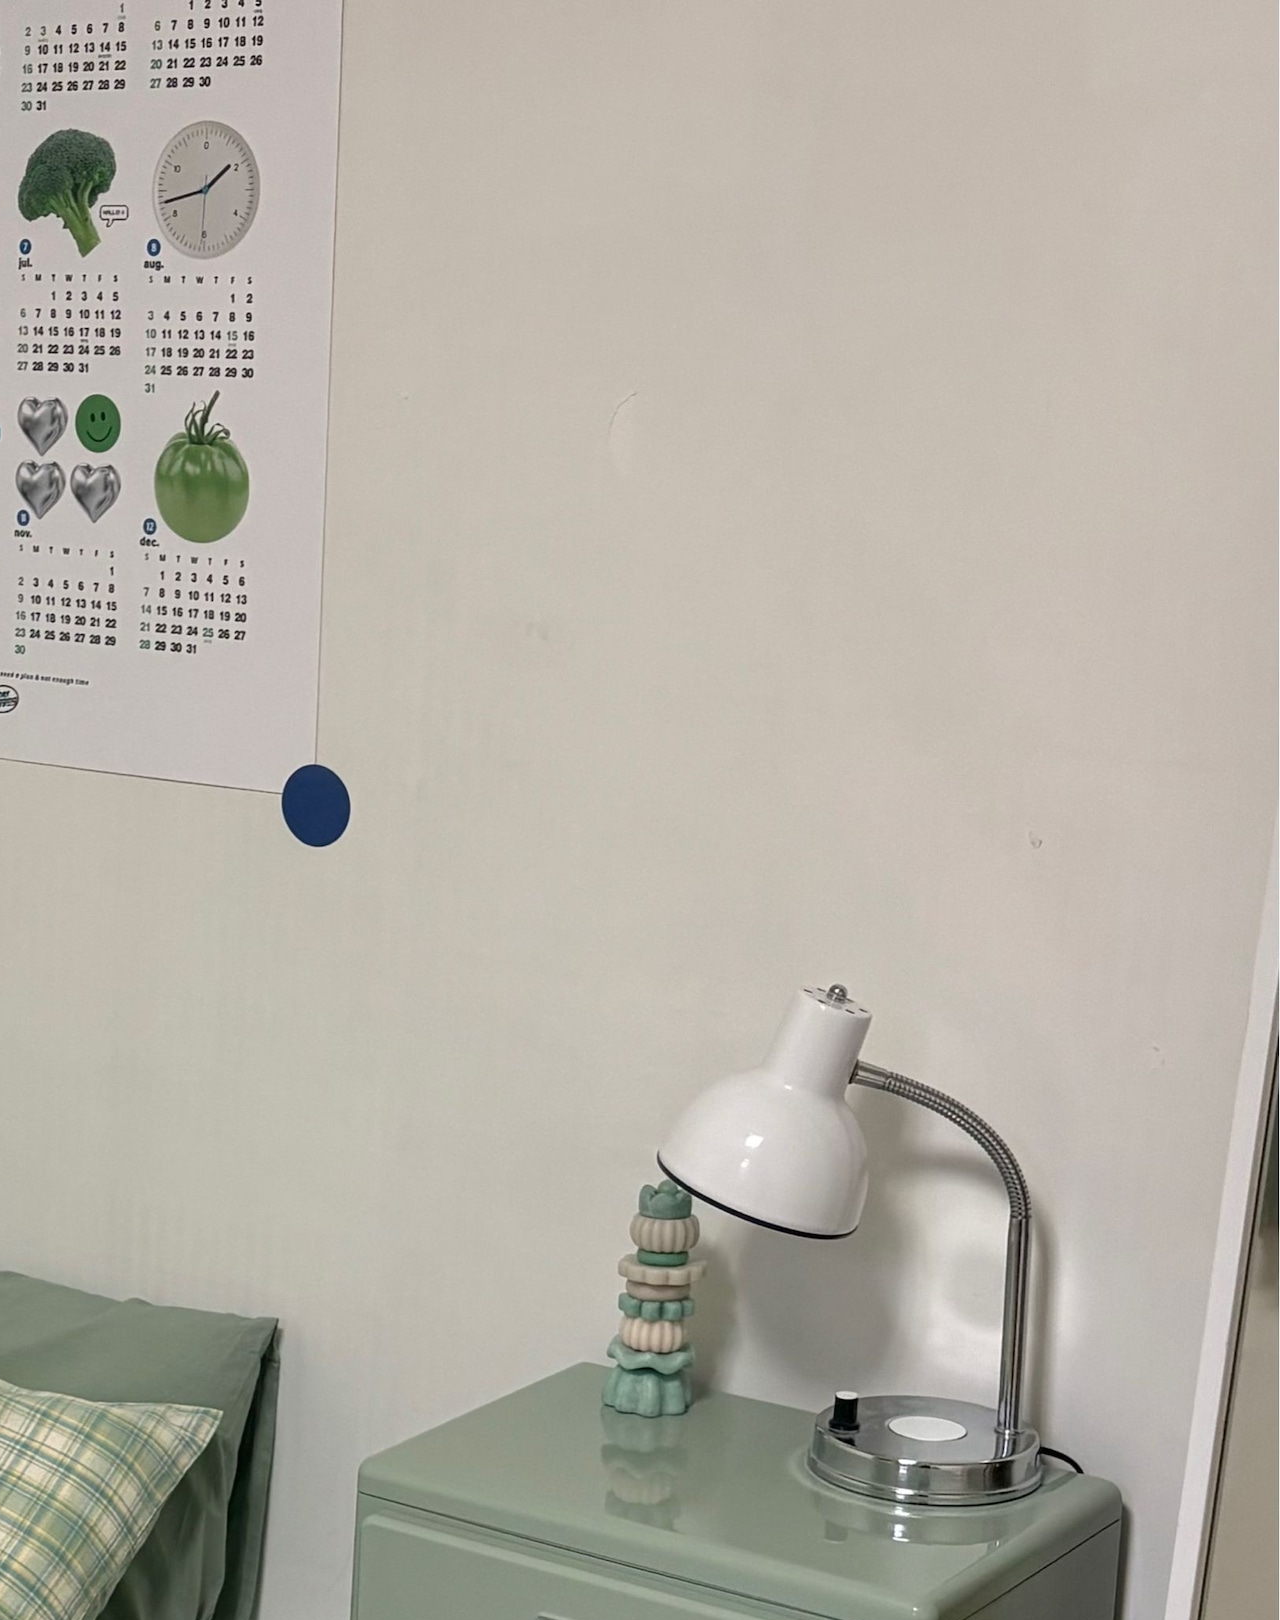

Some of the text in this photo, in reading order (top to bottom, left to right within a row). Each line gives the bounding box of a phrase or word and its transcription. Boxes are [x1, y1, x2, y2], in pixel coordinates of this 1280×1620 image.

[152, 35, 263, 50] 13 14 15 16 17 18 19
[21, 100, 46, 111] 30 31
[204, 142, 209, 150] 0
[174, 165, 181, 173] 10
[234, 164, 239, 172] 2
[18, 257, 33, 270] jul.
[144, 260, 164, 271] aug.
[20, 308, 121, 320] 6 7 8 9 10 11 12
[148, 311, 252, 322] 3 4 5 6 7 8 9
[14, 530, 32, 538] nov.
[140, 537, 160, 547] dec.
[143, 587, 247, 605] 7 8 9 10 11 12 13
[15, 628, 116, 646] 23 24 25 26 27 28 29
